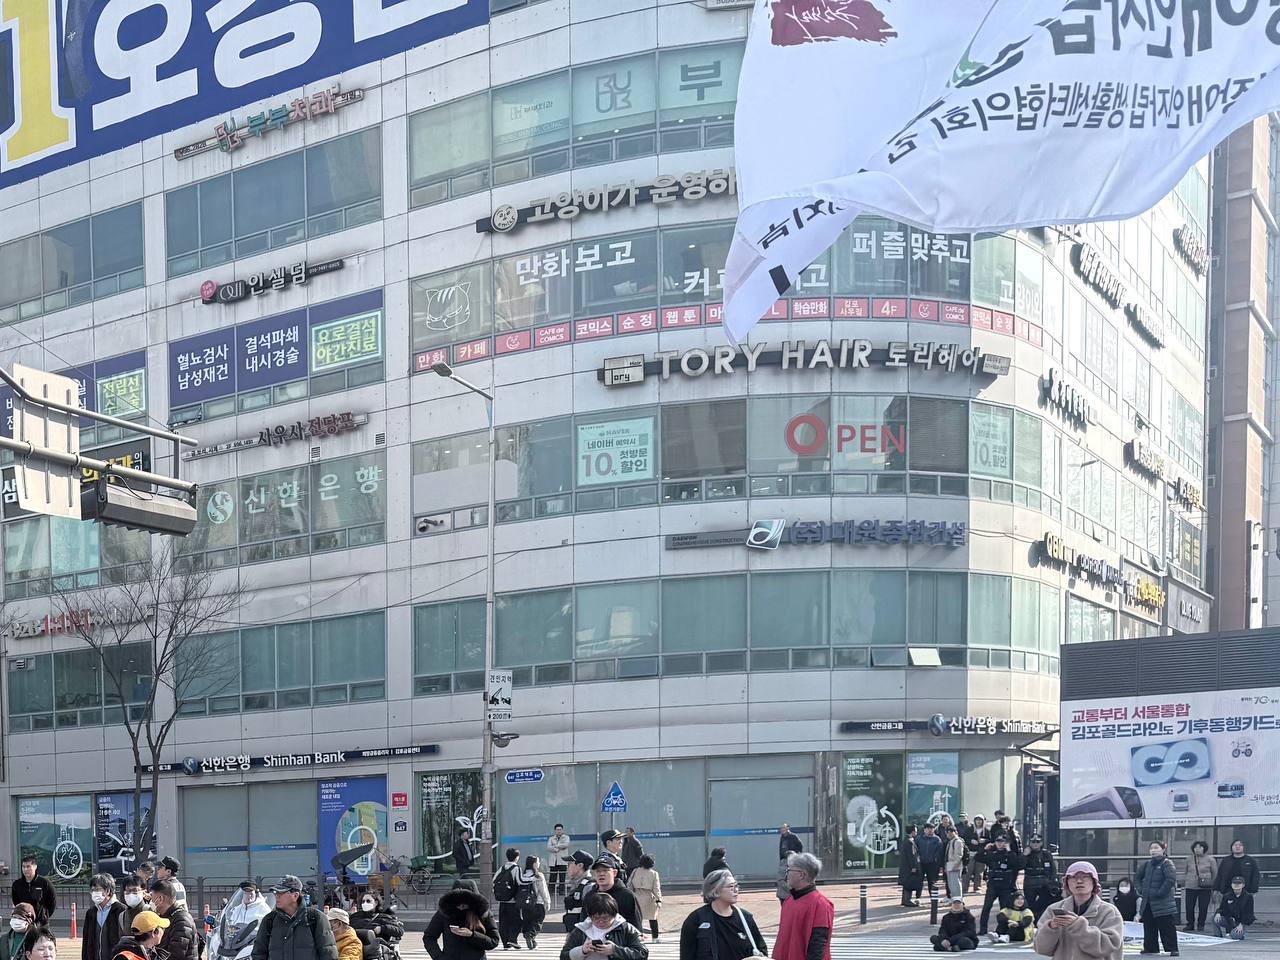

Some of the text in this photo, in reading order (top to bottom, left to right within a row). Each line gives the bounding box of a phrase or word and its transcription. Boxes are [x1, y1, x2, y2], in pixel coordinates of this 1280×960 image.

[526, 179, 640, 223] 고양이가
[248, 260, 308, 297] 인셀덤
[794, 300, 828, 316] 학습만화
[881, 301, 897, 316] 4F
[318, 318, 377, 346] 요로결석
[576, 318, 613, 336] 코믹스
[622, 313, 652, 330] 순정
[246, 326, 300, 355] 결석파쇄
[539, 328, 555, 337] CAFE
[539, 334, 565, 344] COMICS
[177, 344, 229, 371] 혈뇨검사
[246, 347, 300, 373] 내시경술
[317, 334, 378, 365] 야간진료
[418, 349, 445, 368] 만화
[459, 343, 486, 360] 카페
[653, 338, 873, 380] TORY HAIR
[885, 341, 982, 377] 토리헤어
[178, 364, 229, 390] 남성재건
[587, 439, 614, 450] 네이버
[784, 412, 906, 457] OPEN
[620, 448, 648, 460] 첫방문
[621, 458, 648, 474] 할인
[489, 674, 512, 683] 견인지역
[1071, 703, 1191, 724] 교통부터 서울통합
[870, 722, 904, 731] 신한금융그룹
[948, 716, 998, 736] 신한은행
[1071, 720, 1174, 741] 김포골드라인도
[200, 754, 252, 773] 신한은행
[263, 753, 312, 769] Shinhan
[314, 751, 346, 765] Bank
